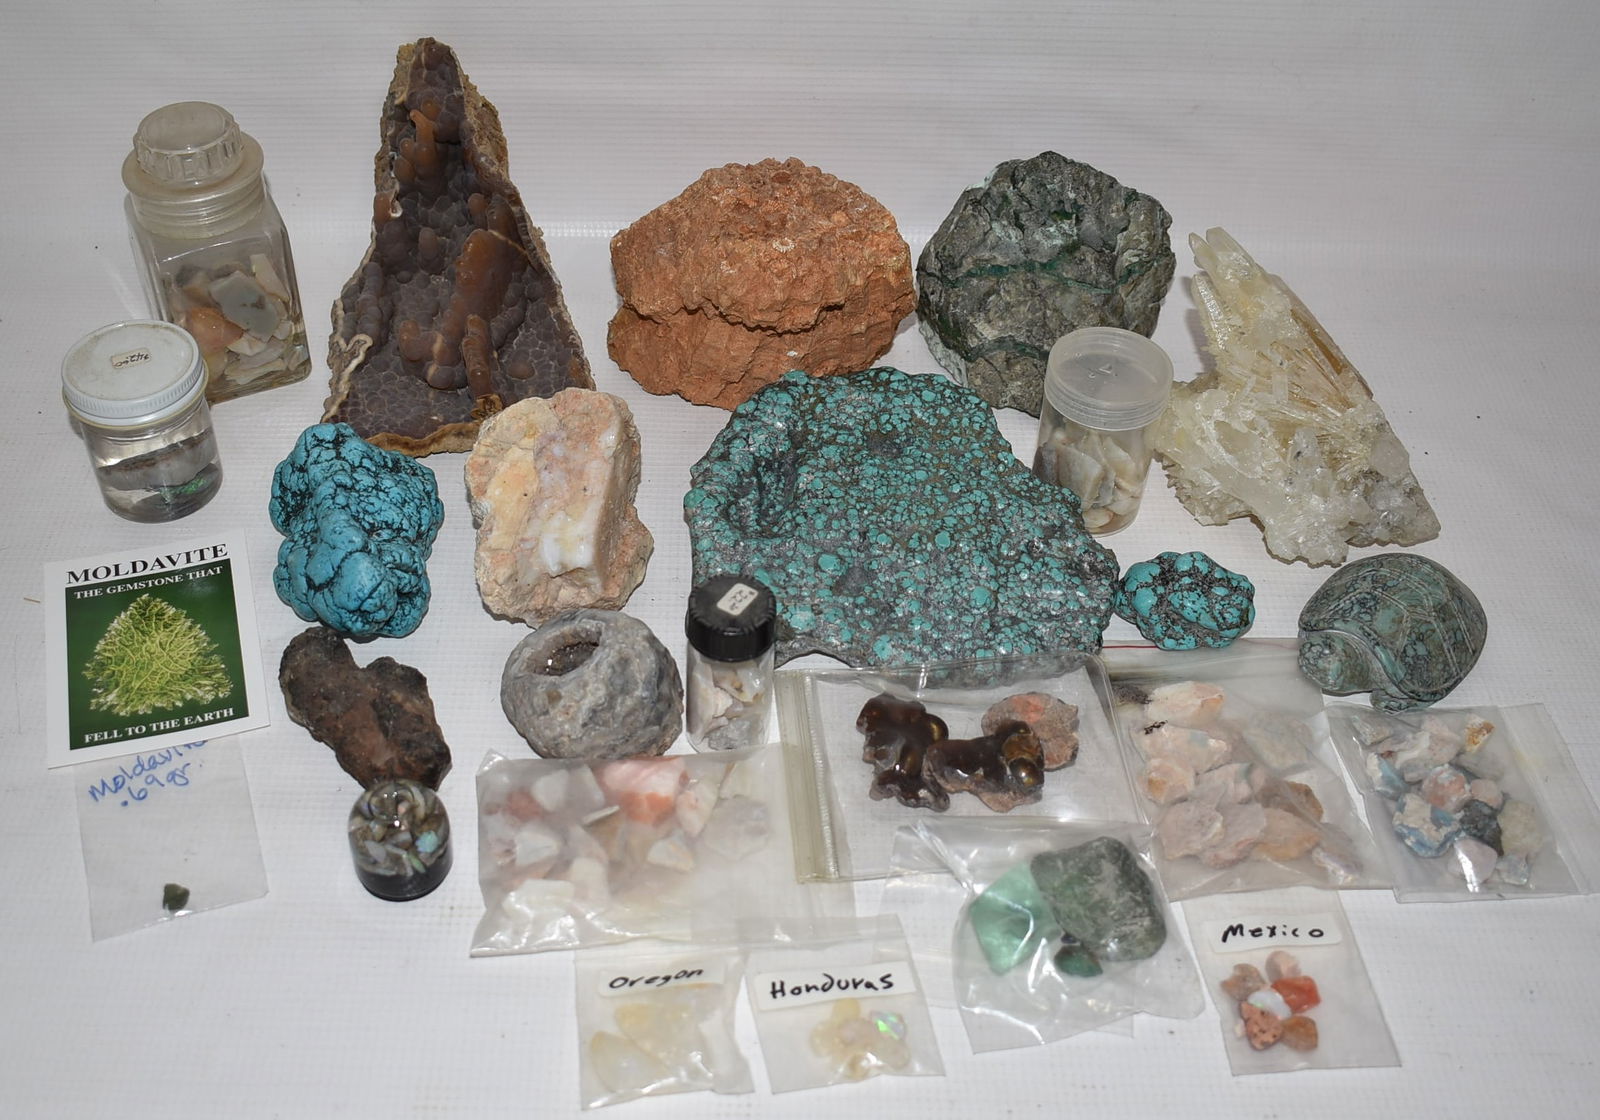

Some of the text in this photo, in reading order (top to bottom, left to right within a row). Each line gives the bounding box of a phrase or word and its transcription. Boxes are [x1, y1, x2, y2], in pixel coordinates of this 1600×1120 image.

[67, 543, 228, 584] MOLDAVITE
[74, 566, 223, 600] THE GEMSTONE THAT
[84, 708, 234, 743] FELL TO THE EARTH
[1221, 923, 1324, 943] Mexico
[608, 967, 704, 989] Oregon
[770, 973, 894, 999] Honduras
